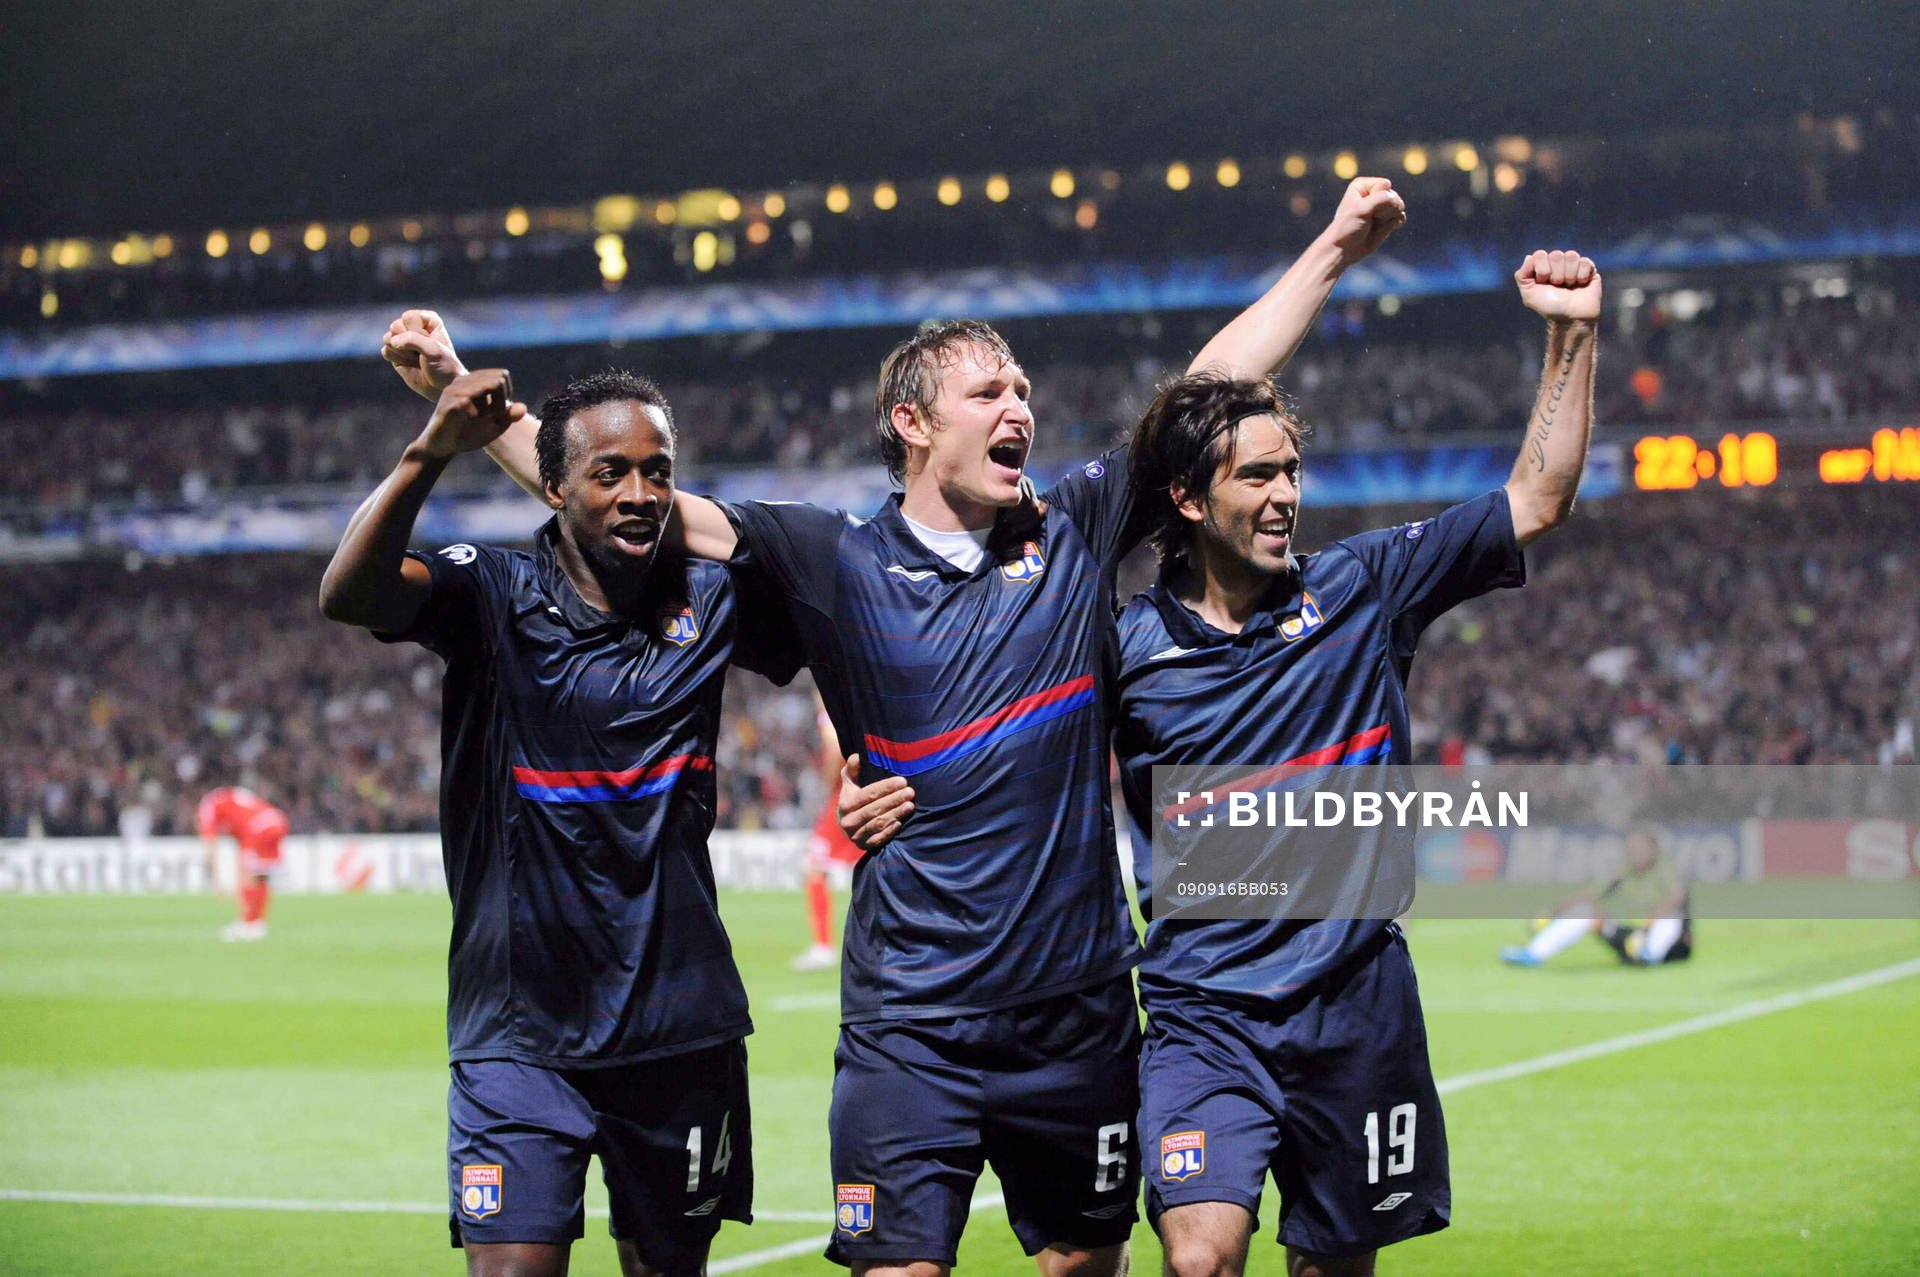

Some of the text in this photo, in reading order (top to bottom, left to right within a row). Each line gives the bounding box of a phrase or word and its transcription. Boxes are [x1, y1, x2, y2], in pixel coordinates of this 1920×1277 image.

[662, 616, 697, 638] OL
[686, 1110, 733, 1192] 14
[1363, 1102, 1417, 1184] 19
[1094, 1121, 1129, 1193] 6
[1164, 1149, 1201, 1175] OL
[464, 1185, 498, 1211] OL
[838, 1204, 870, 1228] OL
